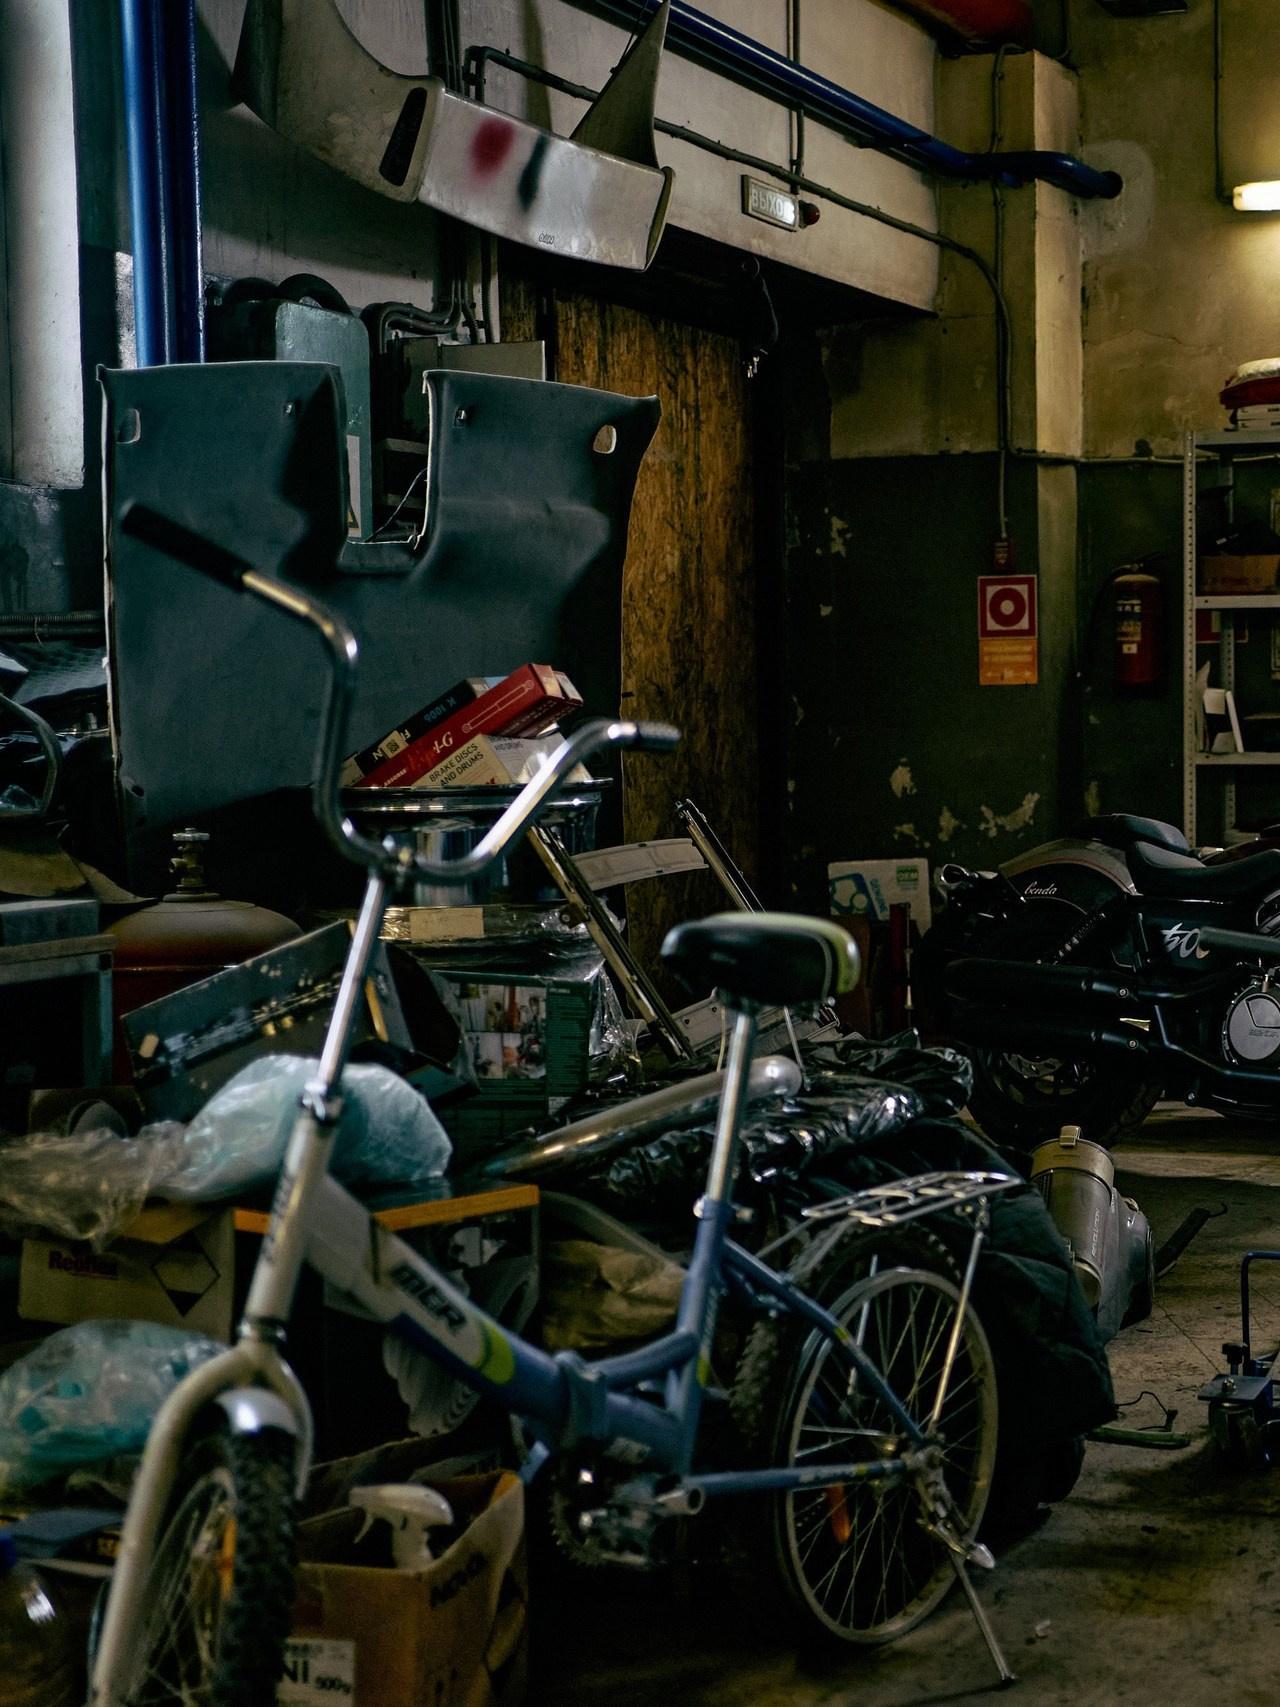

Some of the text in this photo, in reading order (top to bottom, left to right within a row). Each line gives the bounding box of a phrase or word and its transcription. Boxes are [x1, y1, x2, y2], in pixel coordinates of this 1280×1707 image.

[429, 743, 478, 782] BRAKE DISCS
[440, 767, 457, 787] AND
[455, 751, 484, 775] DRUMS
[1024, 881, 1058, 895] benda
